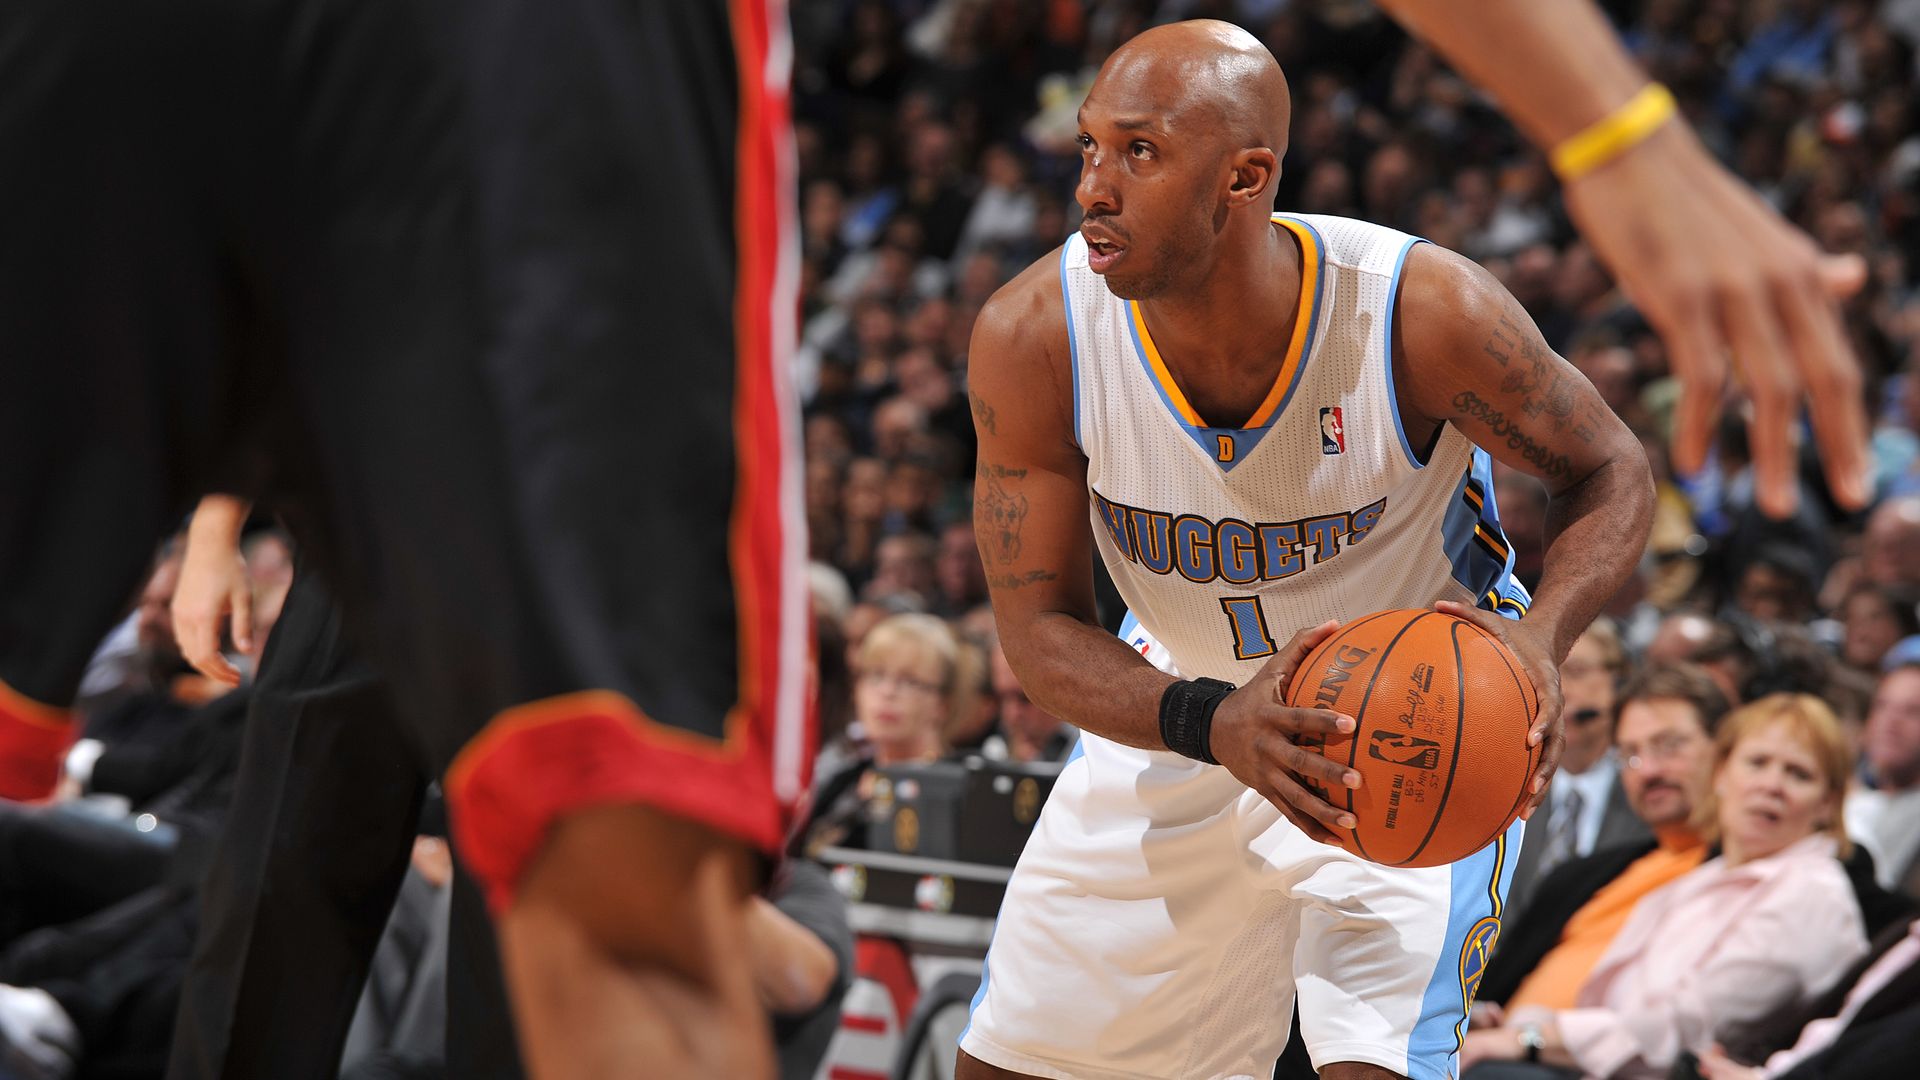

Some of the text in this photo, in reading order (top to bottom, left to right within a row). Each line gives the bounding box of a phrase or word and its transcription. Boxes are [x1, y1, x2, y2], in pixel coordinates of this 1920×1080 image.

[1217, 434, 1234, 463] D
[1323, 444, 1338, 453] NBA
[1092, 488, 1387, 584] NUGGETS
[1219, 595, 1278, 660] 1
[1424, 750, 1437, 768] NBA
[1392, 773, 1405, 789] BALL
[1389, 789, 1402, 807] GAME
